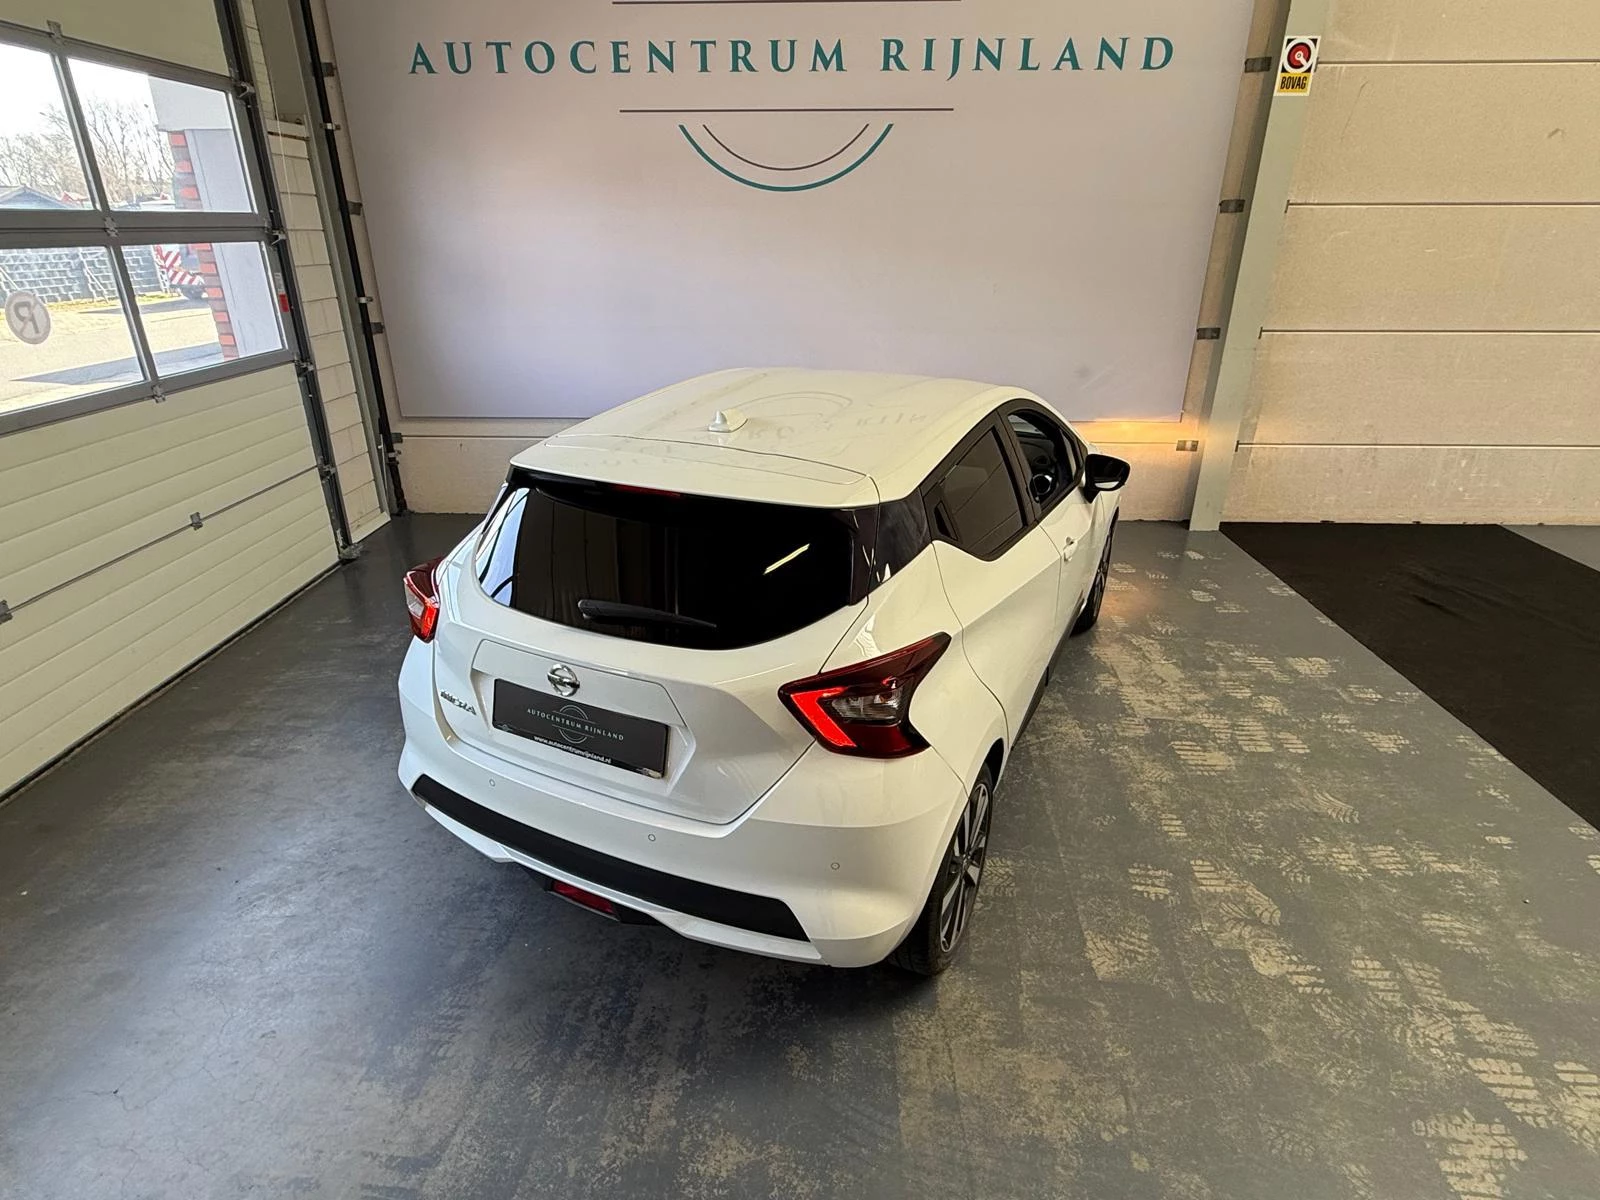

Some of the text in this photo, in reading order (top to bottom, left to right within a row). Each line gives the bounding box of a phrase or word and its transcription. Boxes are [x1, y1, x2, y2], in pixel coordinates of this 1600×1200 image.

[408, 36, 1174, 82] AUTOCENTRUM RIJNLAND
[1280, 76, 1307, 90] BOVAG
[527, 708, 624, 741] AUTOCENTRUM RIJNLAND
[533, 735, 612, 764] www.autocentrumrijnland.nl
